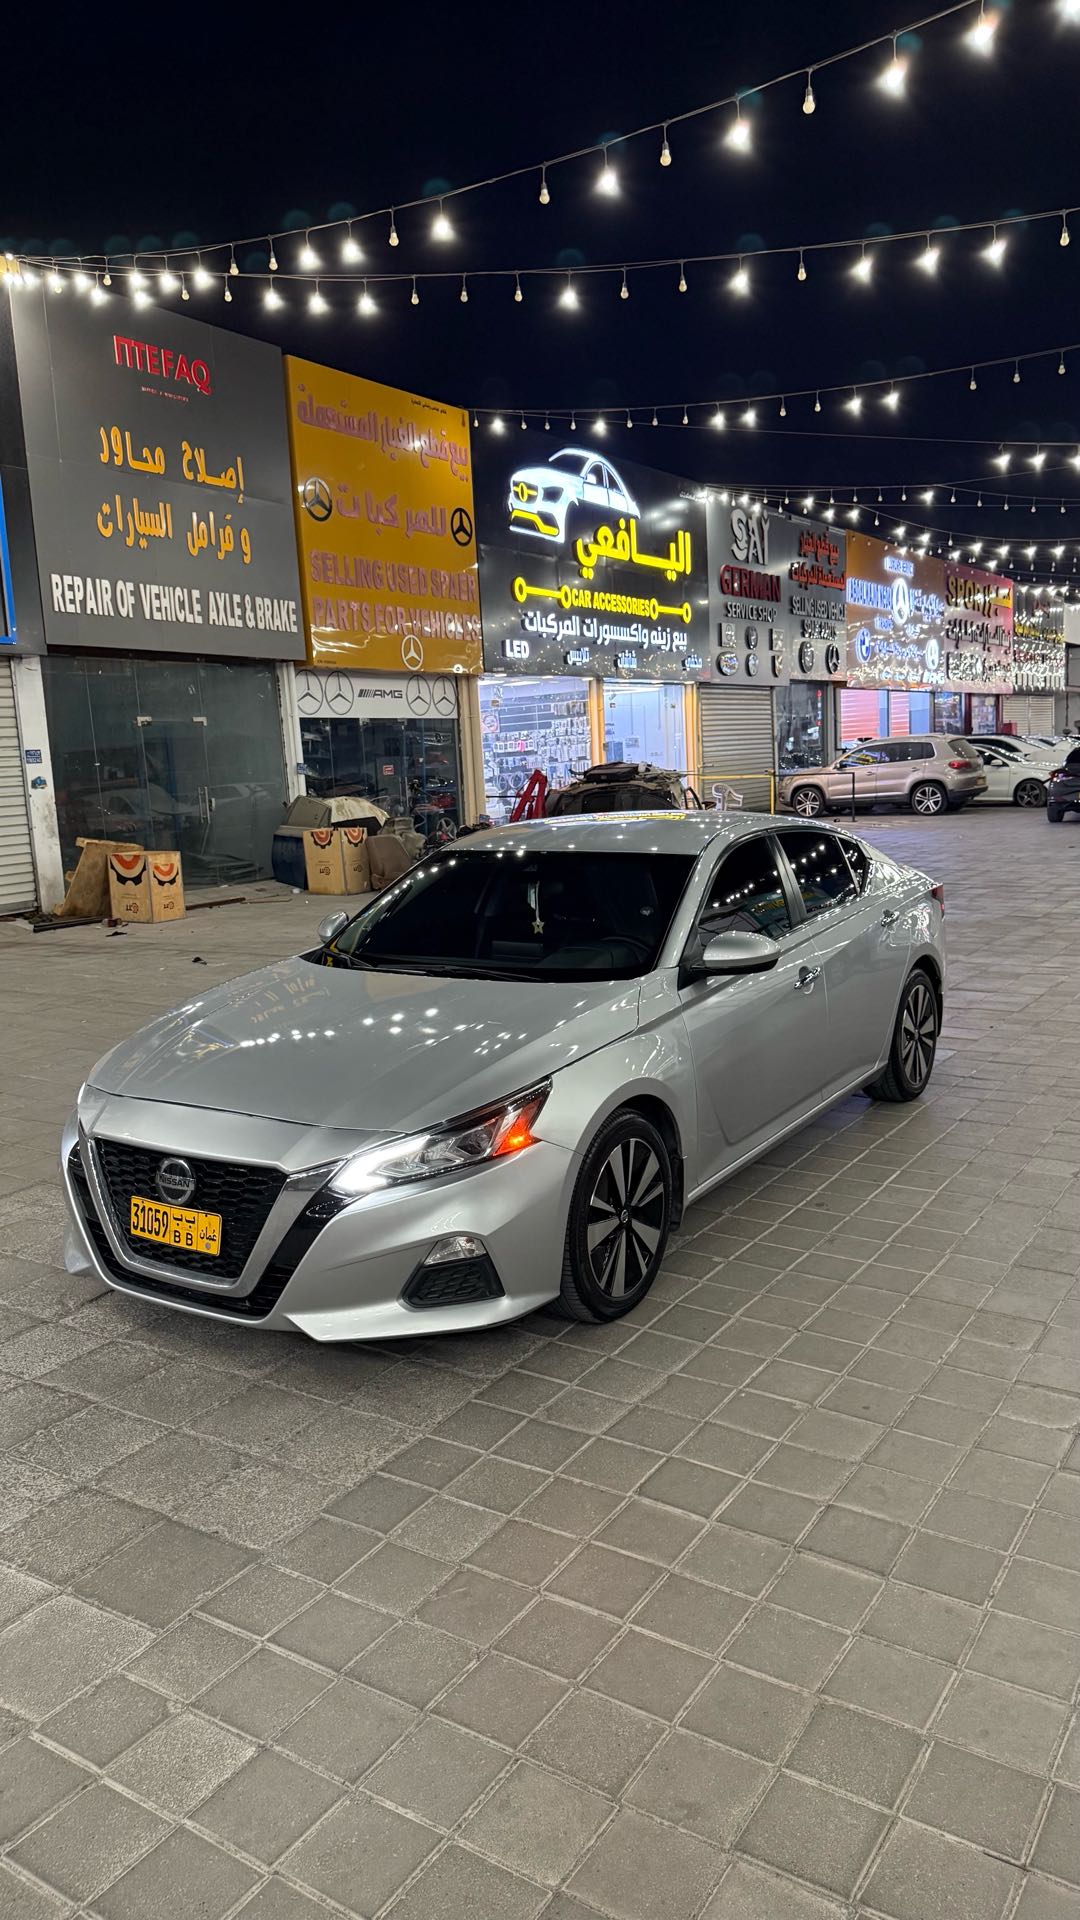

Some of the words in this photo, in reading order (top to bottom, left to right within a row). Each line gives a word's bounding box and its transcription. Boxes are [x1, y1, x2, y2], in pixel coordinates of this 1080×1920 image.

[100, 426, 165, 475] محاور
[380, 416, 419, 461] الغيار
[418, 428, 450, 469] قطع
[182, 441, 244, 503] إصلاح
[450, 441, 469, 482] بيع
[97, 495, 172, 549] السيارات
[187, 511, 234, 560] فرامل
[576, 518, 692, 581] اليافعي
[310, 550, 384, 590] SELLING
[385, 562, 428, 597] USED
[720, 564, 781, 602] GERMAN
[51, 574, 114, 617] REPAIR
[116, 580, 135, 619] OF
[139, 583, 202, 625] VEHICLE
[208, 593, 243, 628] AXLE
[245, 596, 255, 629] &
[256, 597, 298, 633] BRAKE
[312, 597, 371, 632] PARTS
[374, 603, 408, 636] FOR
[408, 607, 480, 641] VEHICLES
[571, 589, 592, 609] CAR
[593, 592, 650, 617] ACCESSORIES
[726, 601, 757, 620] SERVICE
[758, 606, 778, 622] SHOP
[792, 595, 814, 617] SELLING
[523, 611, 580, 640] المركبات
[672, 631, 688, 652] بيع
[504, 639, 530, 659] LED
[160, 1176, 190, 1188] NISSAN
[132, 1202, 169, 1239] 31059
